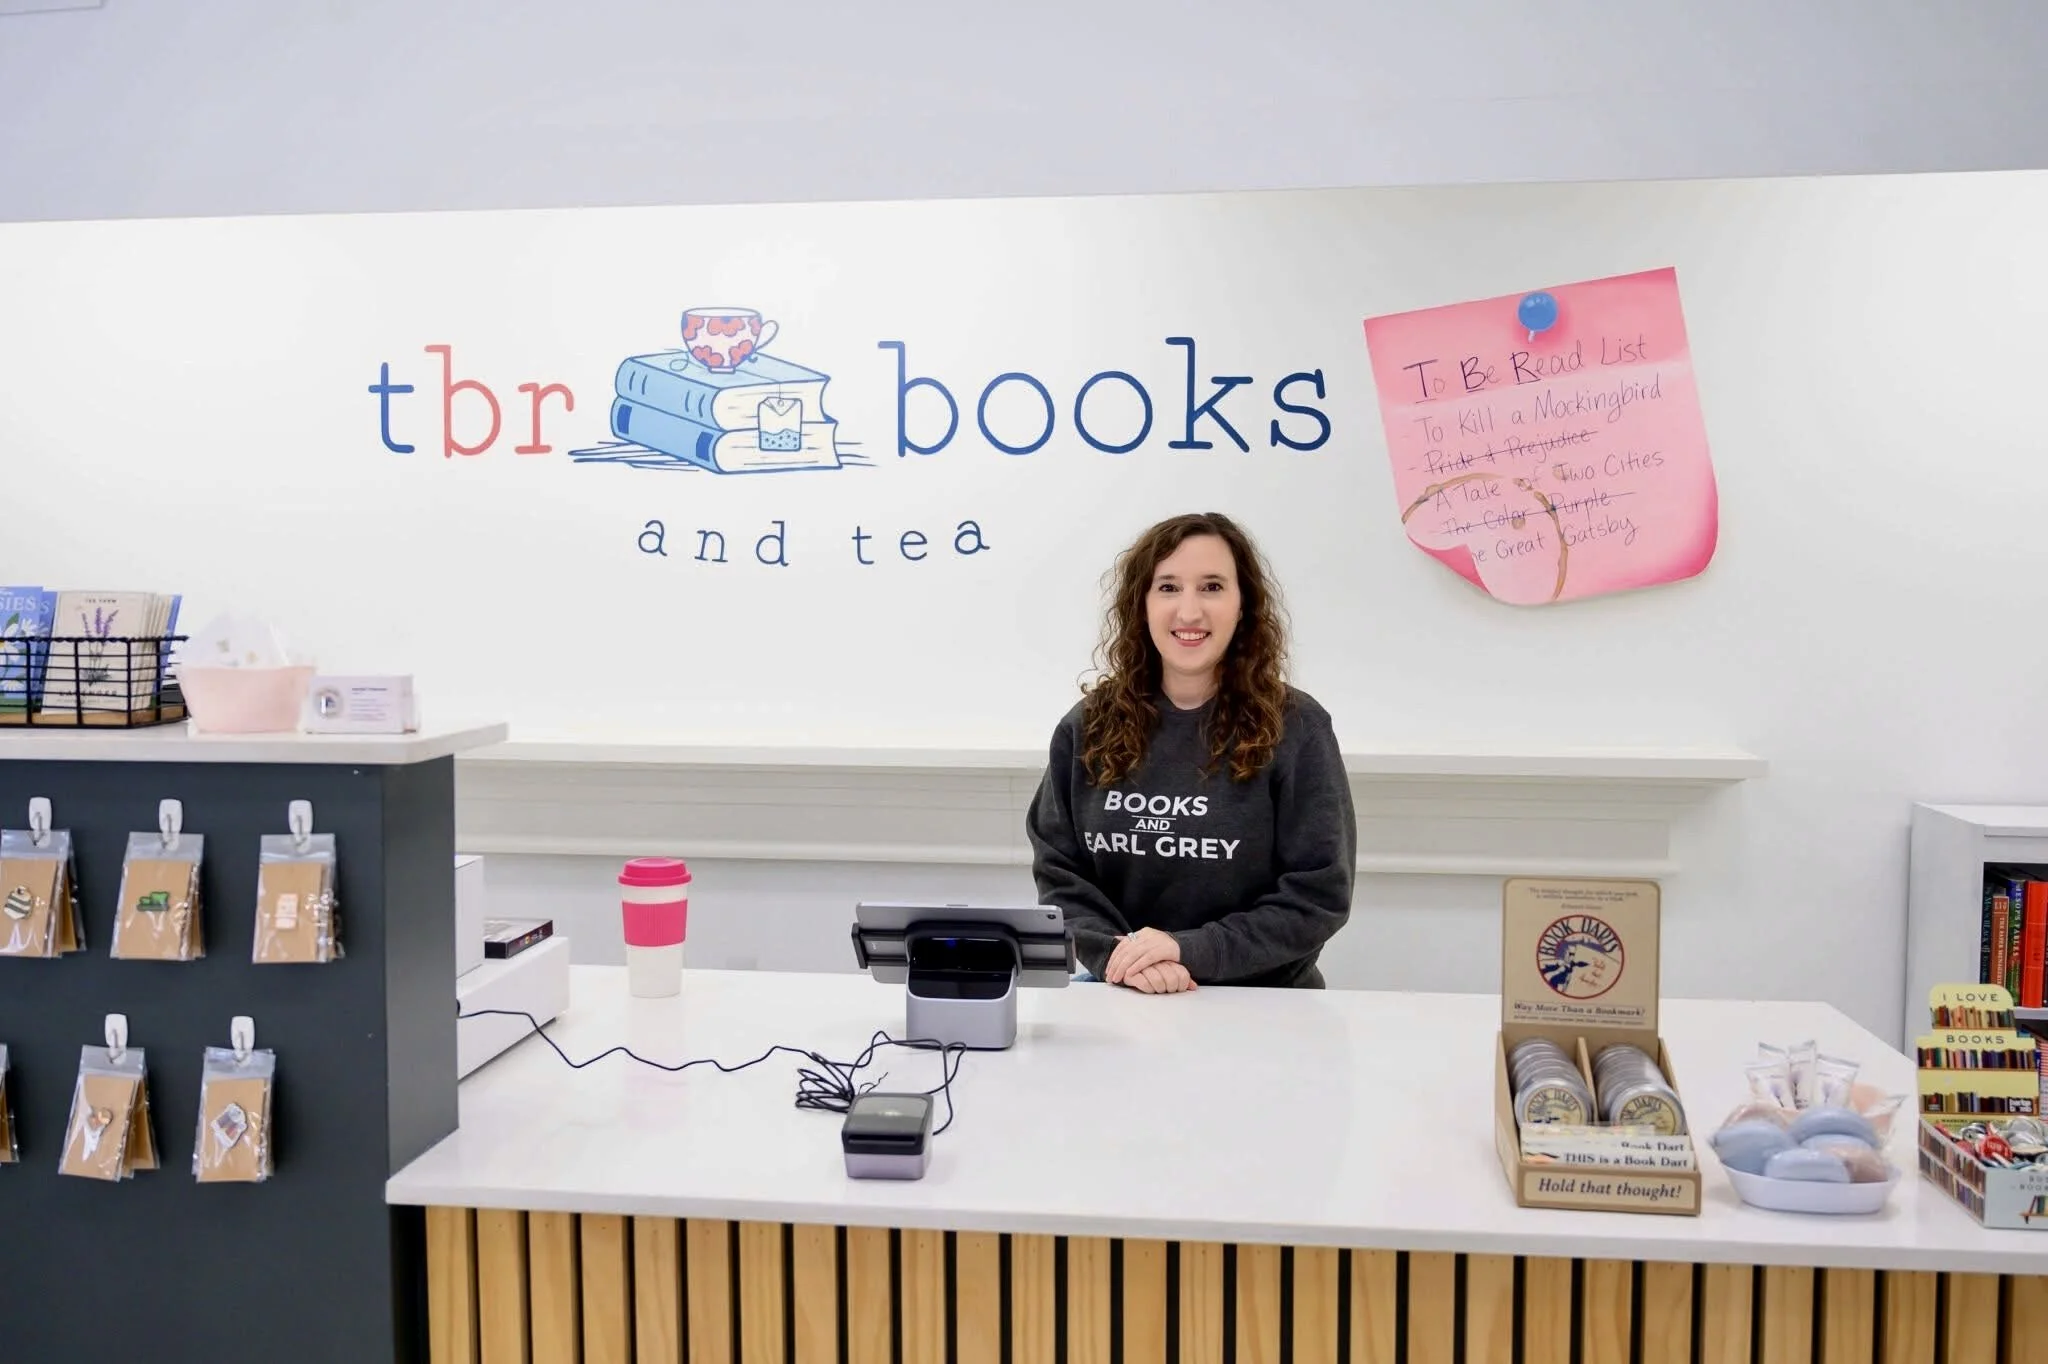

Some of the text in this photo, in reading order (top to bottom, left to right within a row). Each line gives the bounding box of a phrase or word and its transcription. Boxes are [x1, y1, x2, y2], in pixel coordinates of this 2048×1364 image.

[1403, 335, 1648, 398] To Be Read List
[368, 336, 1332, 458] tbr books
[1413, 373, 1663, 444] To Kill a Mockingbird
[1424, 449, 1474, 474] Pride
[1504, 430, 1594, 464] Prejudice
[1434, 488, 1453, 513] A
[1452, 479, 1502, 503] Tale
[1553, 460, 1596, 485] Two
[1603, 448, 1666, 479] Cities
[1483, 503, 1531, 530] Color
[1550, 488, 1611, 518] Purple
[637, 519, 990, 568] and tea
[1495, 530, 1545, 560] Great
[1562, 515, 1639, 547] Gatsby
[1104, 790, 1209, 817] BOOKS
[1135, 819, 1171, 831] AND
[1155, 836, 1241, 860] GREY
[1539, 916, 1620, 957] BOOK DARTS
[1514, 1002, 1532, 1011] Way
[1535, 1003, 1558, 1012] More
[1562, 1005, 1584, 1014] Than
[1595, 1006, 1646, 1017] Bookmark!
[1956, 992, 1999, 1002] LOVE
[1946, 1034, 2005, 1045] BOOKS
[1563, 1152, 1688, 1168] THIS is a Book Dart
[1657, 1141, 1685, 1152] Dart
[1538, 1177, 1683, 1201] Hold that thought!
